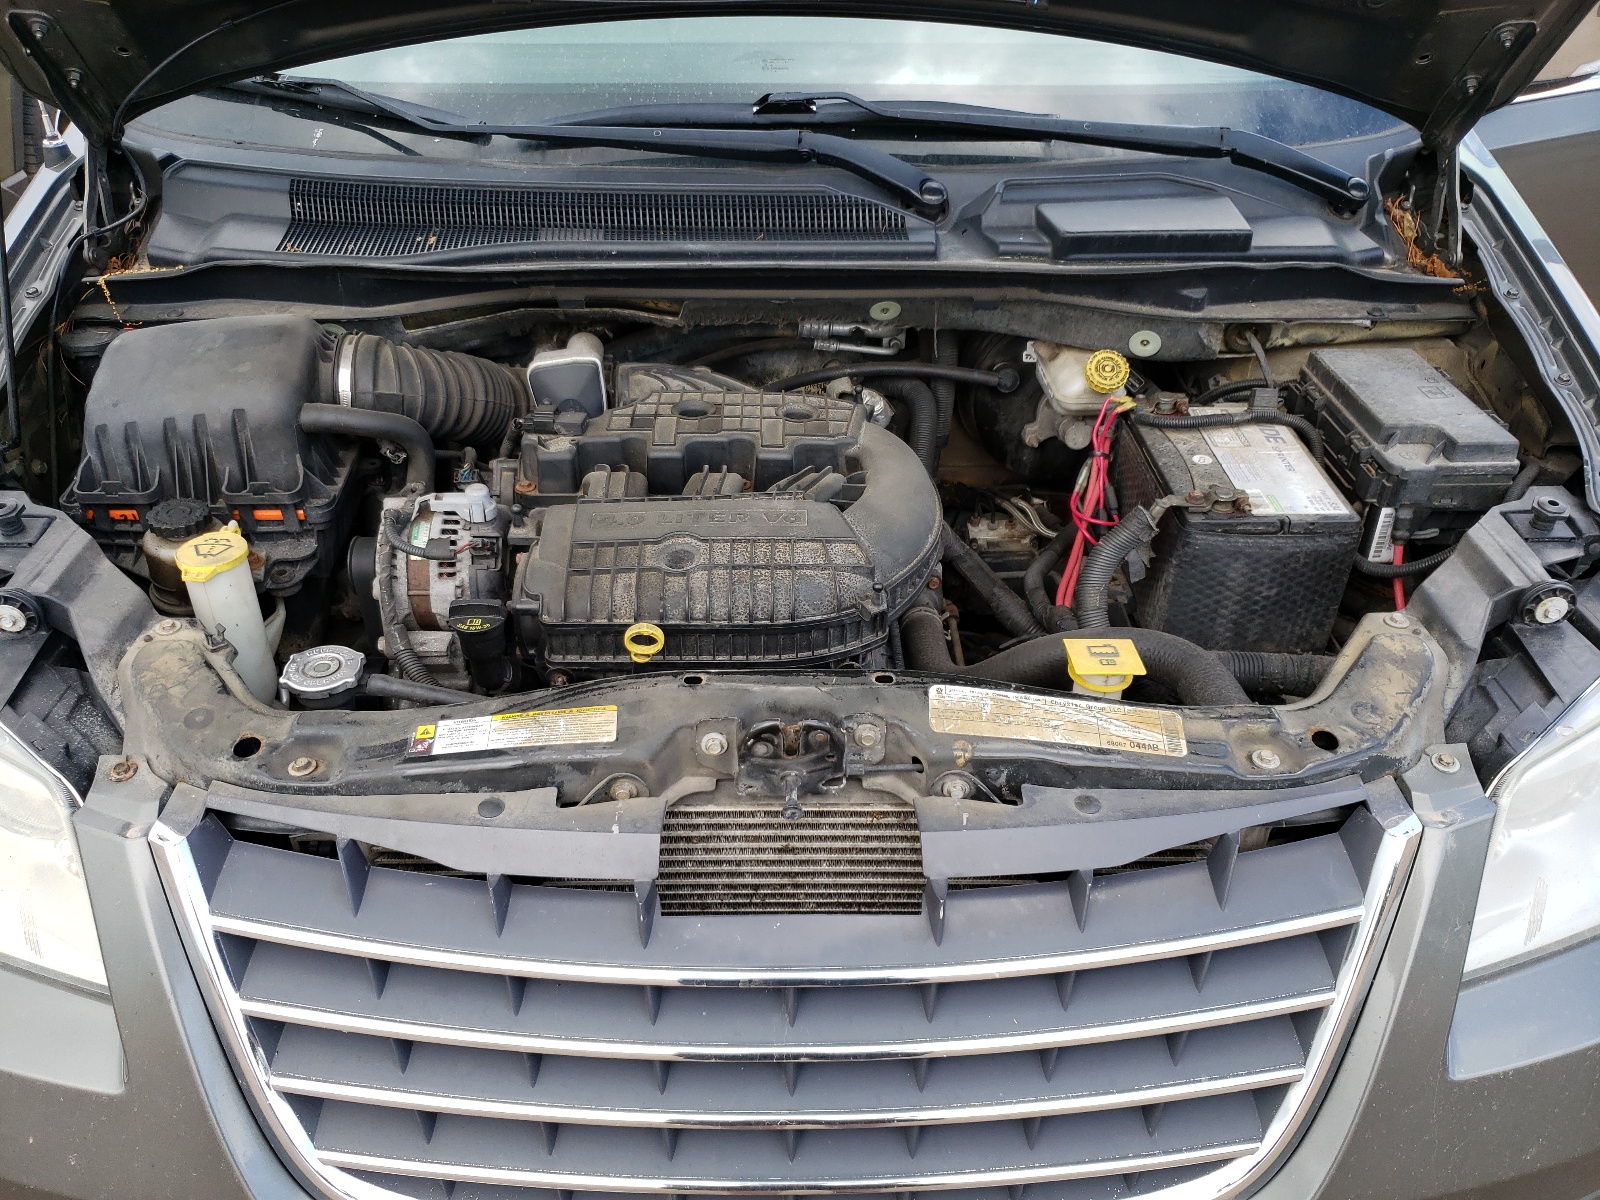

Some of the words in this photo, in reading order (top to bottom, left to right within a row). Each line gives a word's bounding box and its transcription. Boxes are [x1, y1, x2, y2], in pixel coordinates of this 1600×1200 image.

[656, 512, 750, 525] LITER
[763, 511, 803, 525] V6
[1085, 702, 1106, 712] Group
